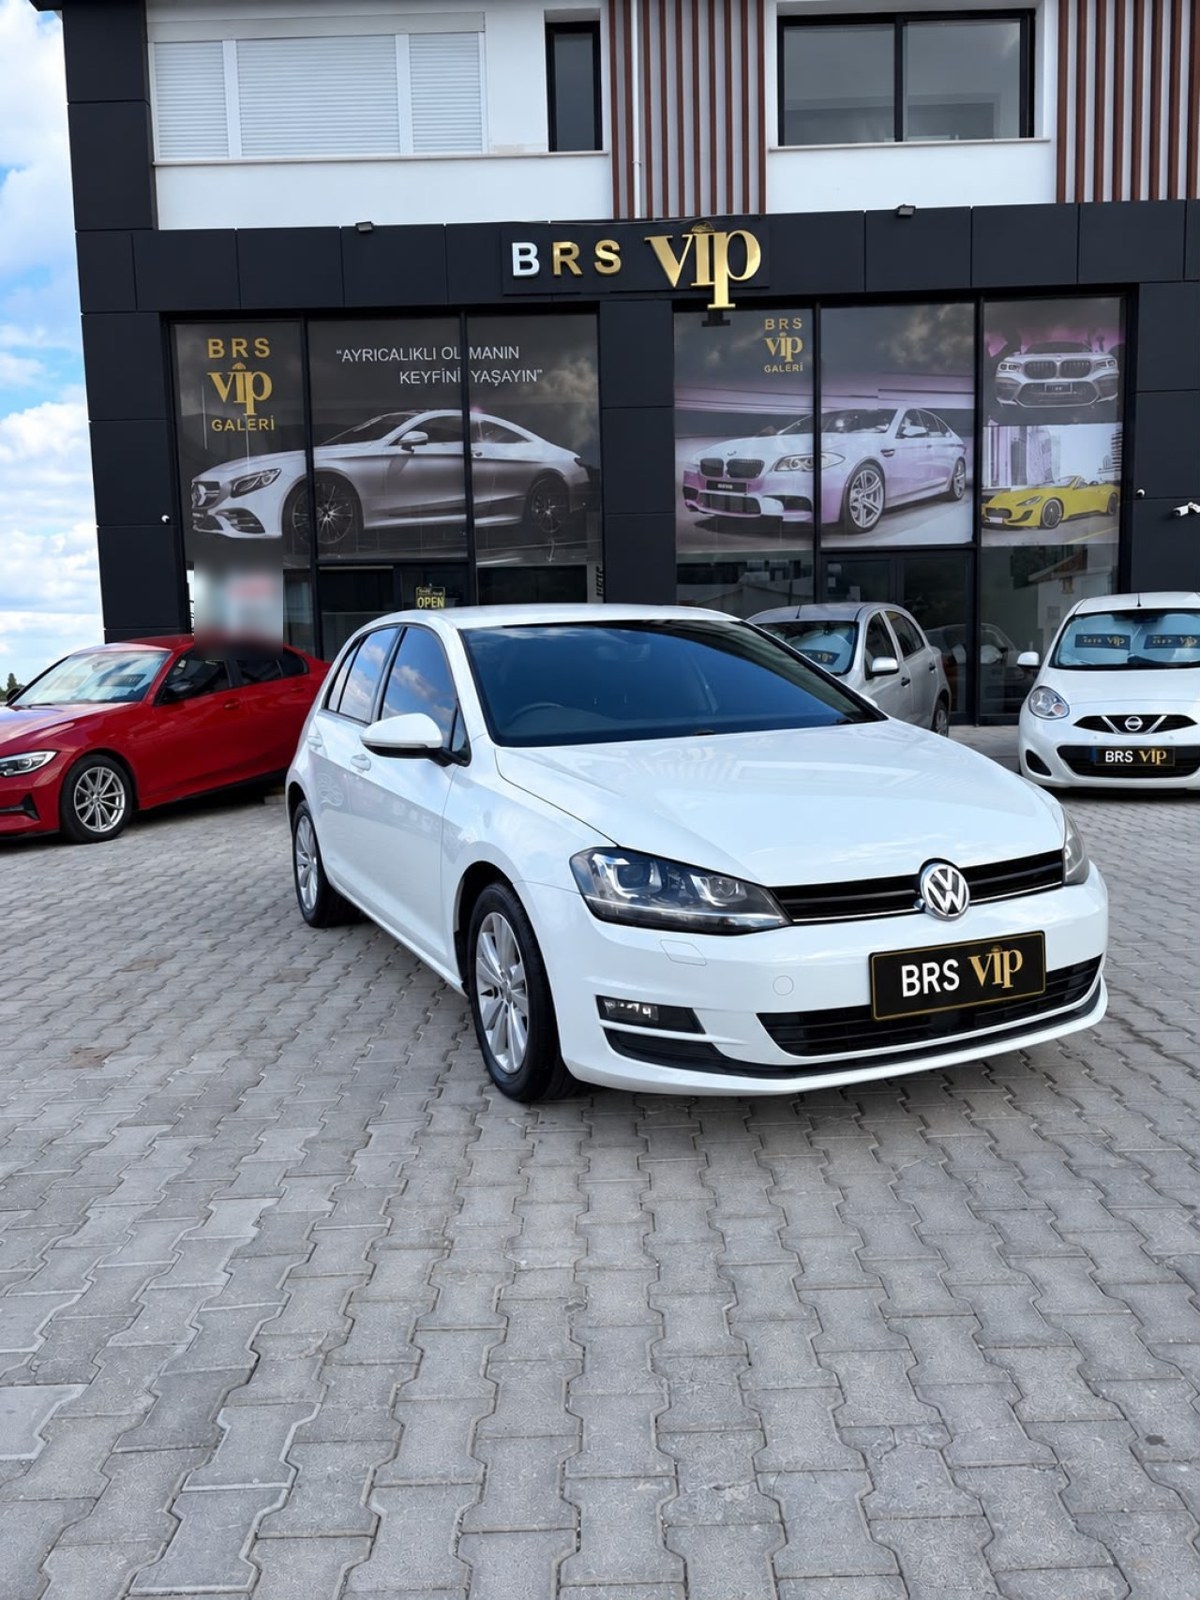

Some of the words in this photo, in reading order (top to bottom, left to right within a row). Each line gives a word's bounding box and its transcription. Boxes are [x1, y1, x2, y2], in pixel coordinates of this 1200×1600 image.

[511, 239, 622, 277] BRS
[764, 317, 803, 331] BRS
[207, 337, 271, 358] BRS
[399, 367, 462, 384] KEYFİNİ
[764, 361, 804, 374] GALERİ
[211, 415, 275, 431] GALERİ
[416, 596, 445, 608] OPEN
[1105, 750, 1134, 763] BRS
[901, 959, 960, 998] BRS
